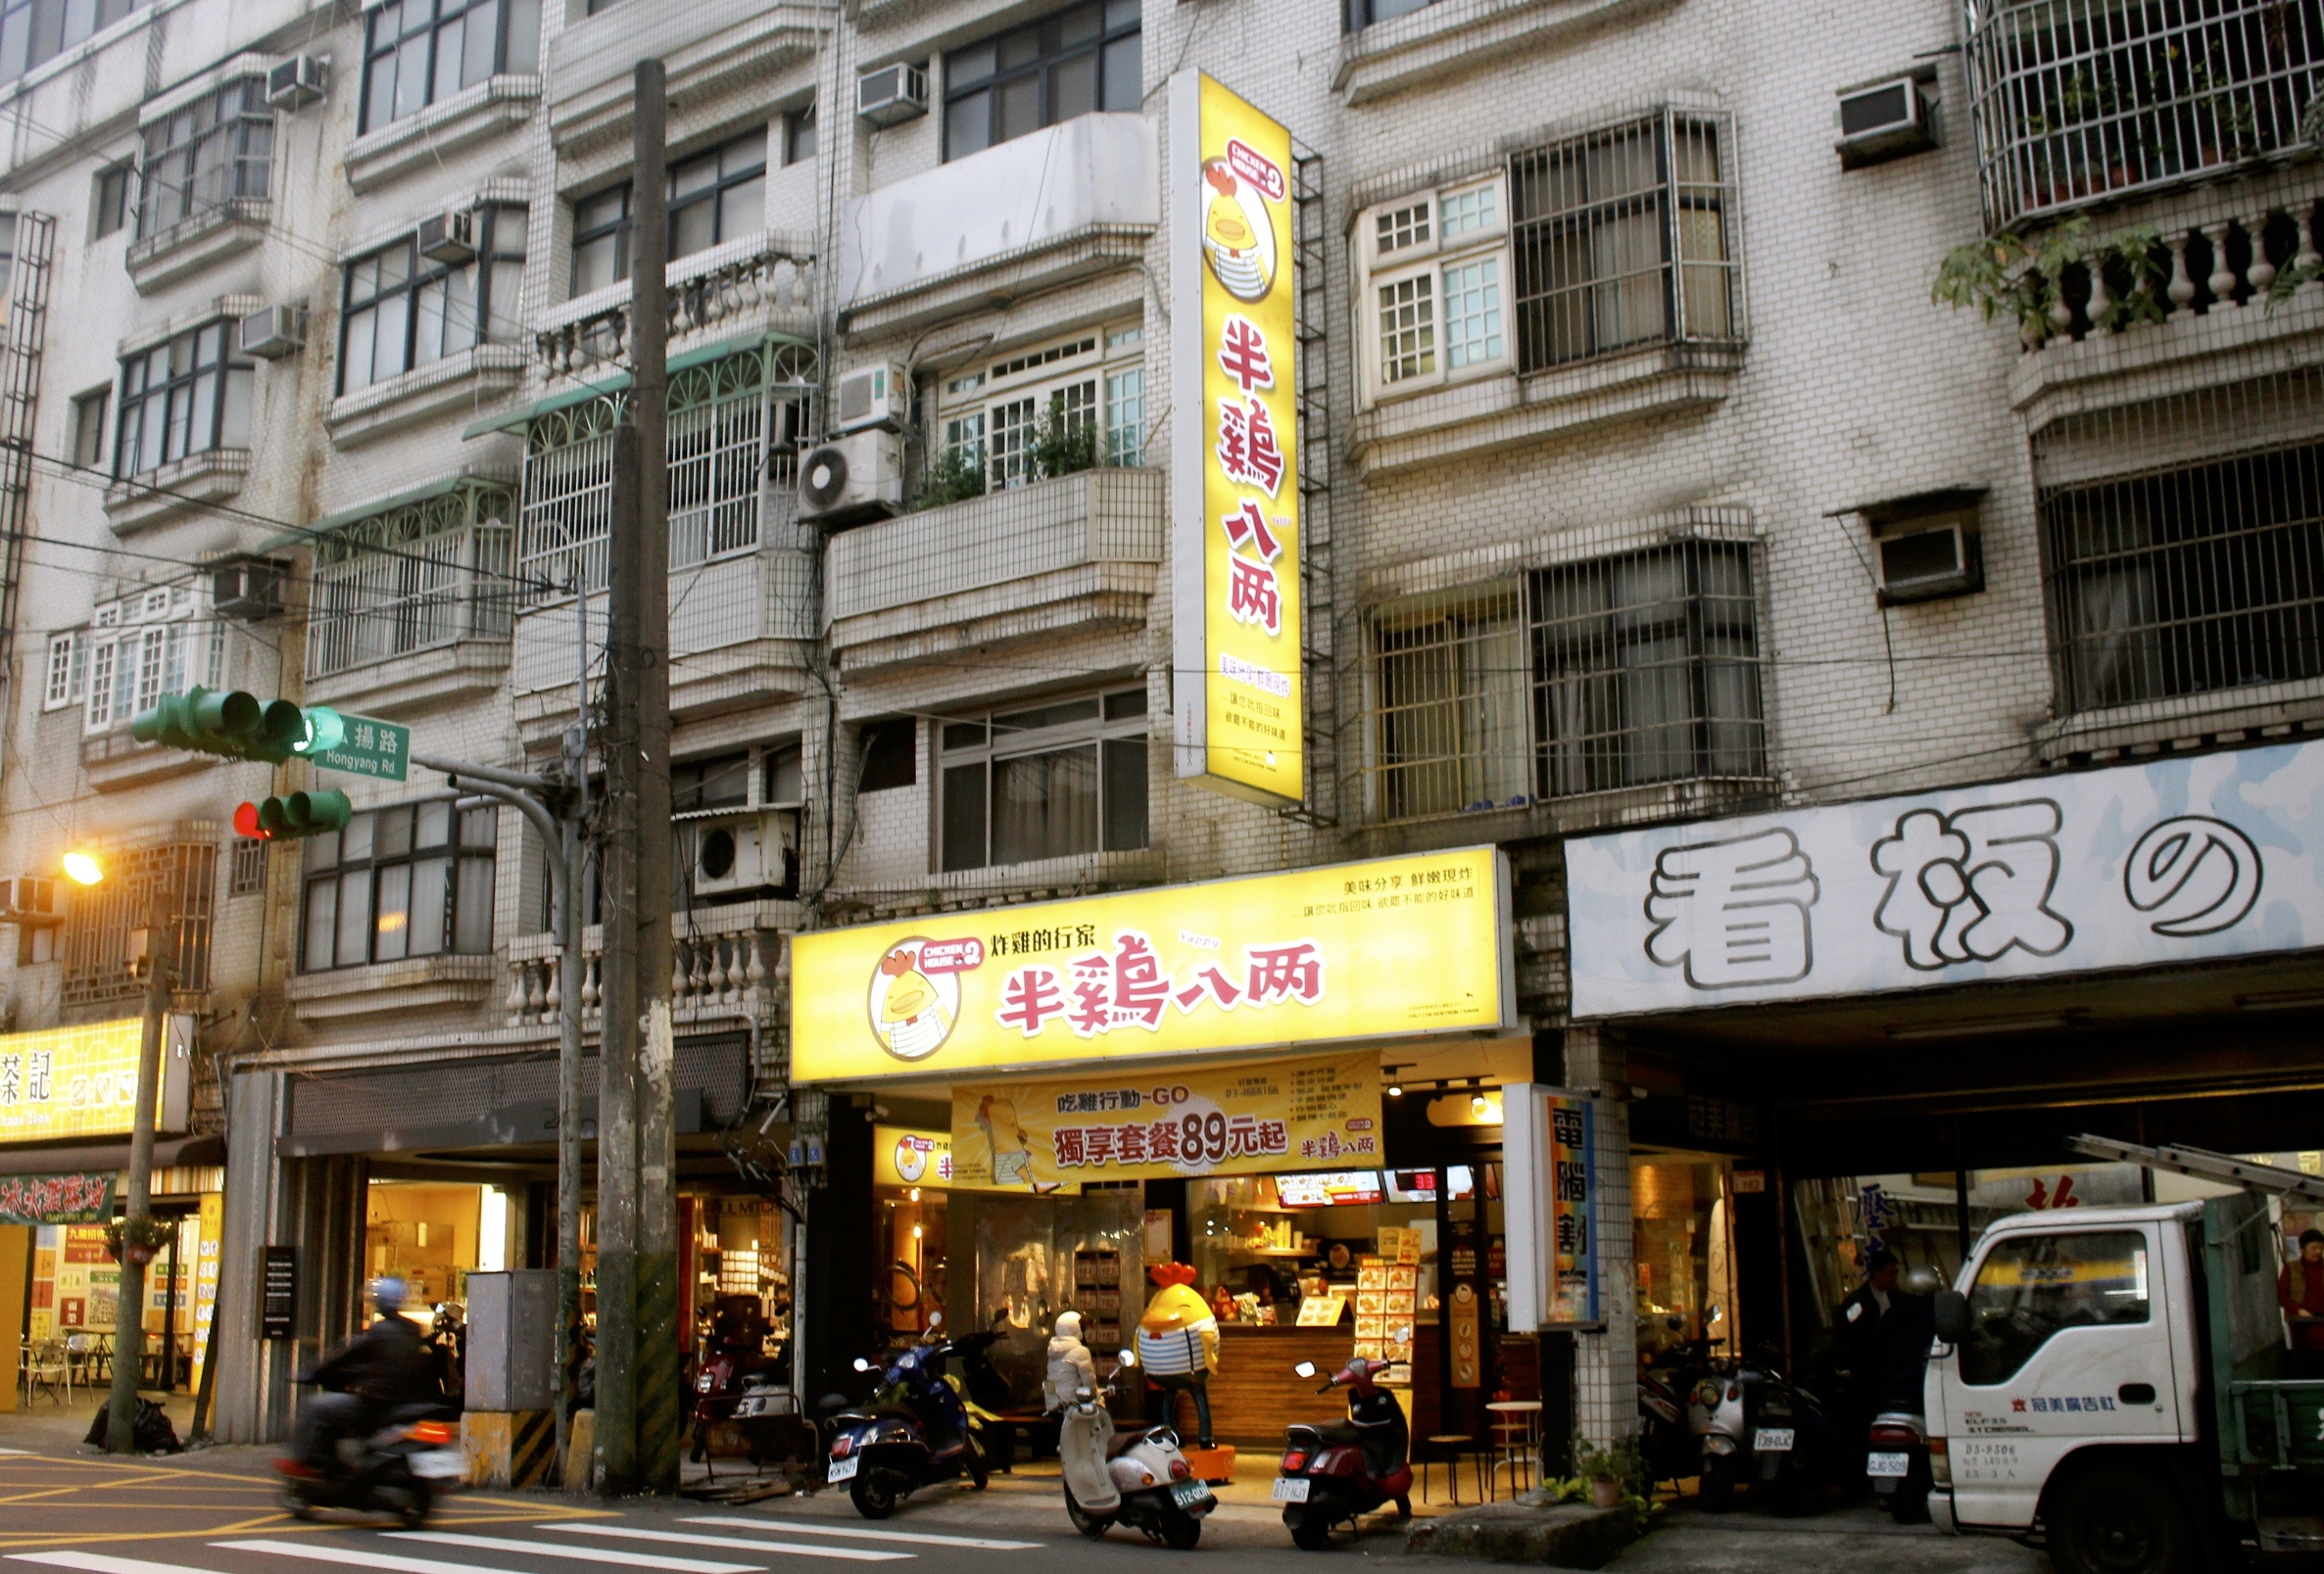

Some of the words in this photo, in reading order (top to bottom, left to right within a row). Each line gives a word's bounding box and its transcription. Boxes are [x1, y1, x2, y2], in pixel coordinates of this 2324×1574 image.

[326, 749, 378, 774] Hongyang
[1343, 875, 1403, 895] 美味分享
[1411, 867, 1473, 888] 鮮嫩現炸
[1644, 797, 2263, 990] 看板の
[1378, 886, 1475, 909] 欲罷不能的好味道
[924, 943, 964, 957] CHICKEN
[991, 925, 1095, 957] 炸雞的行家
[924, 956, 954, 969] HOUSE
[1, 1052, 50, 1105] 茶記
